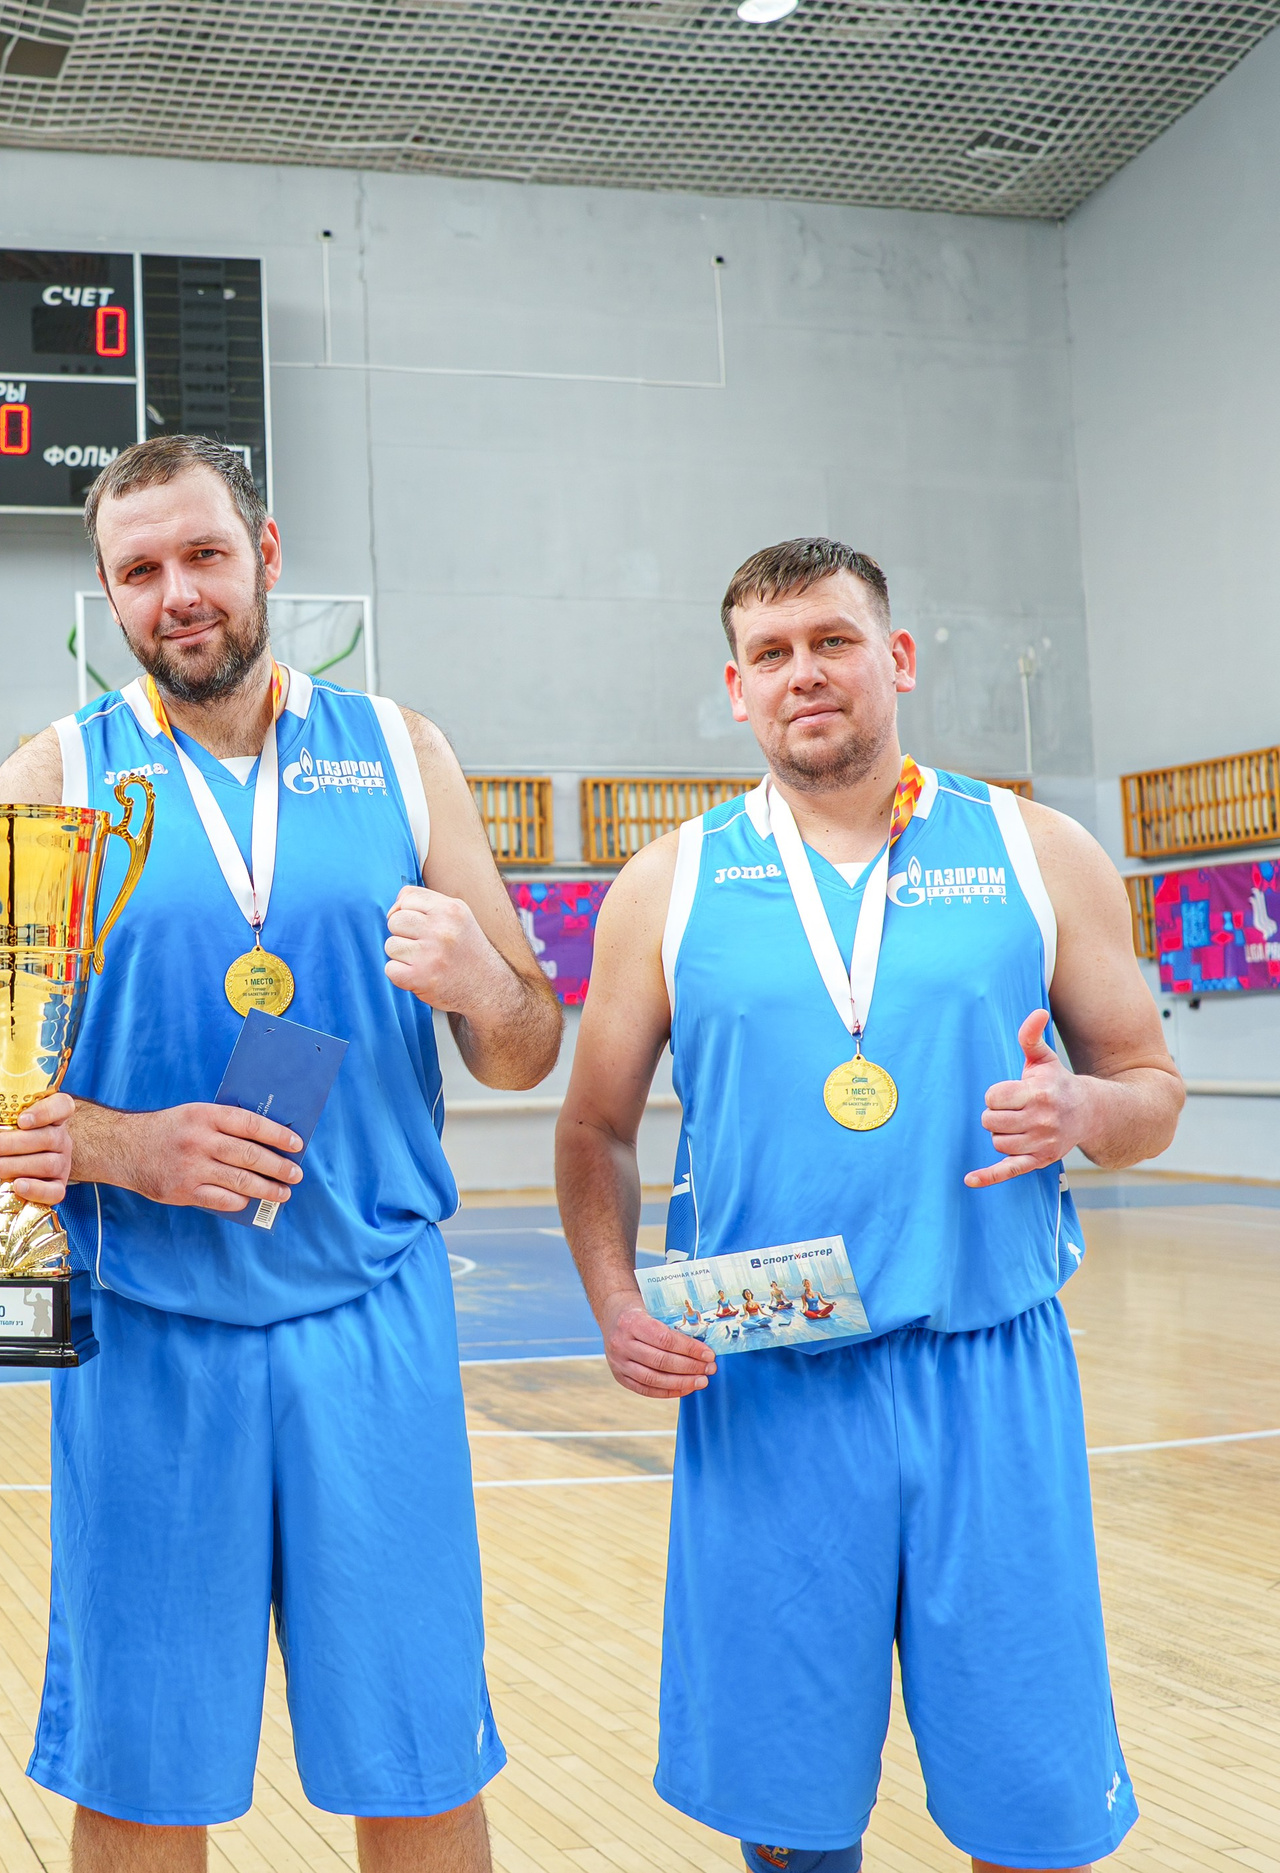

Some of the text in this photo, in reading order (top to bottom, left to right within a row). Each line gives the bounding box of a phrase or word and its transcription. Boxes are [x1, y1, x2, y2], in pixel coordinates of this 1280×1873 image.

[42, 286, 115, 307] СЧЕТ
[95, 306, 127, 357] 0
[315, 759, 384, 778] ГАЗПРОМ
[320, 776, 386, 788] ТРАНСГАЗ
[320, 786, 388, 797] ТОМСК
[924, 866, 1006, 887] ГАЗПРОМ
[928, 886, 1005, 896] ТРАНСГАЗ
[927, 895, 1008, 906] ТОМСК
[250, 977, 274, 985] МЕСТО
[646, 1268, 710, 1284] ПОДАРОЧНАЯ КАРТА
